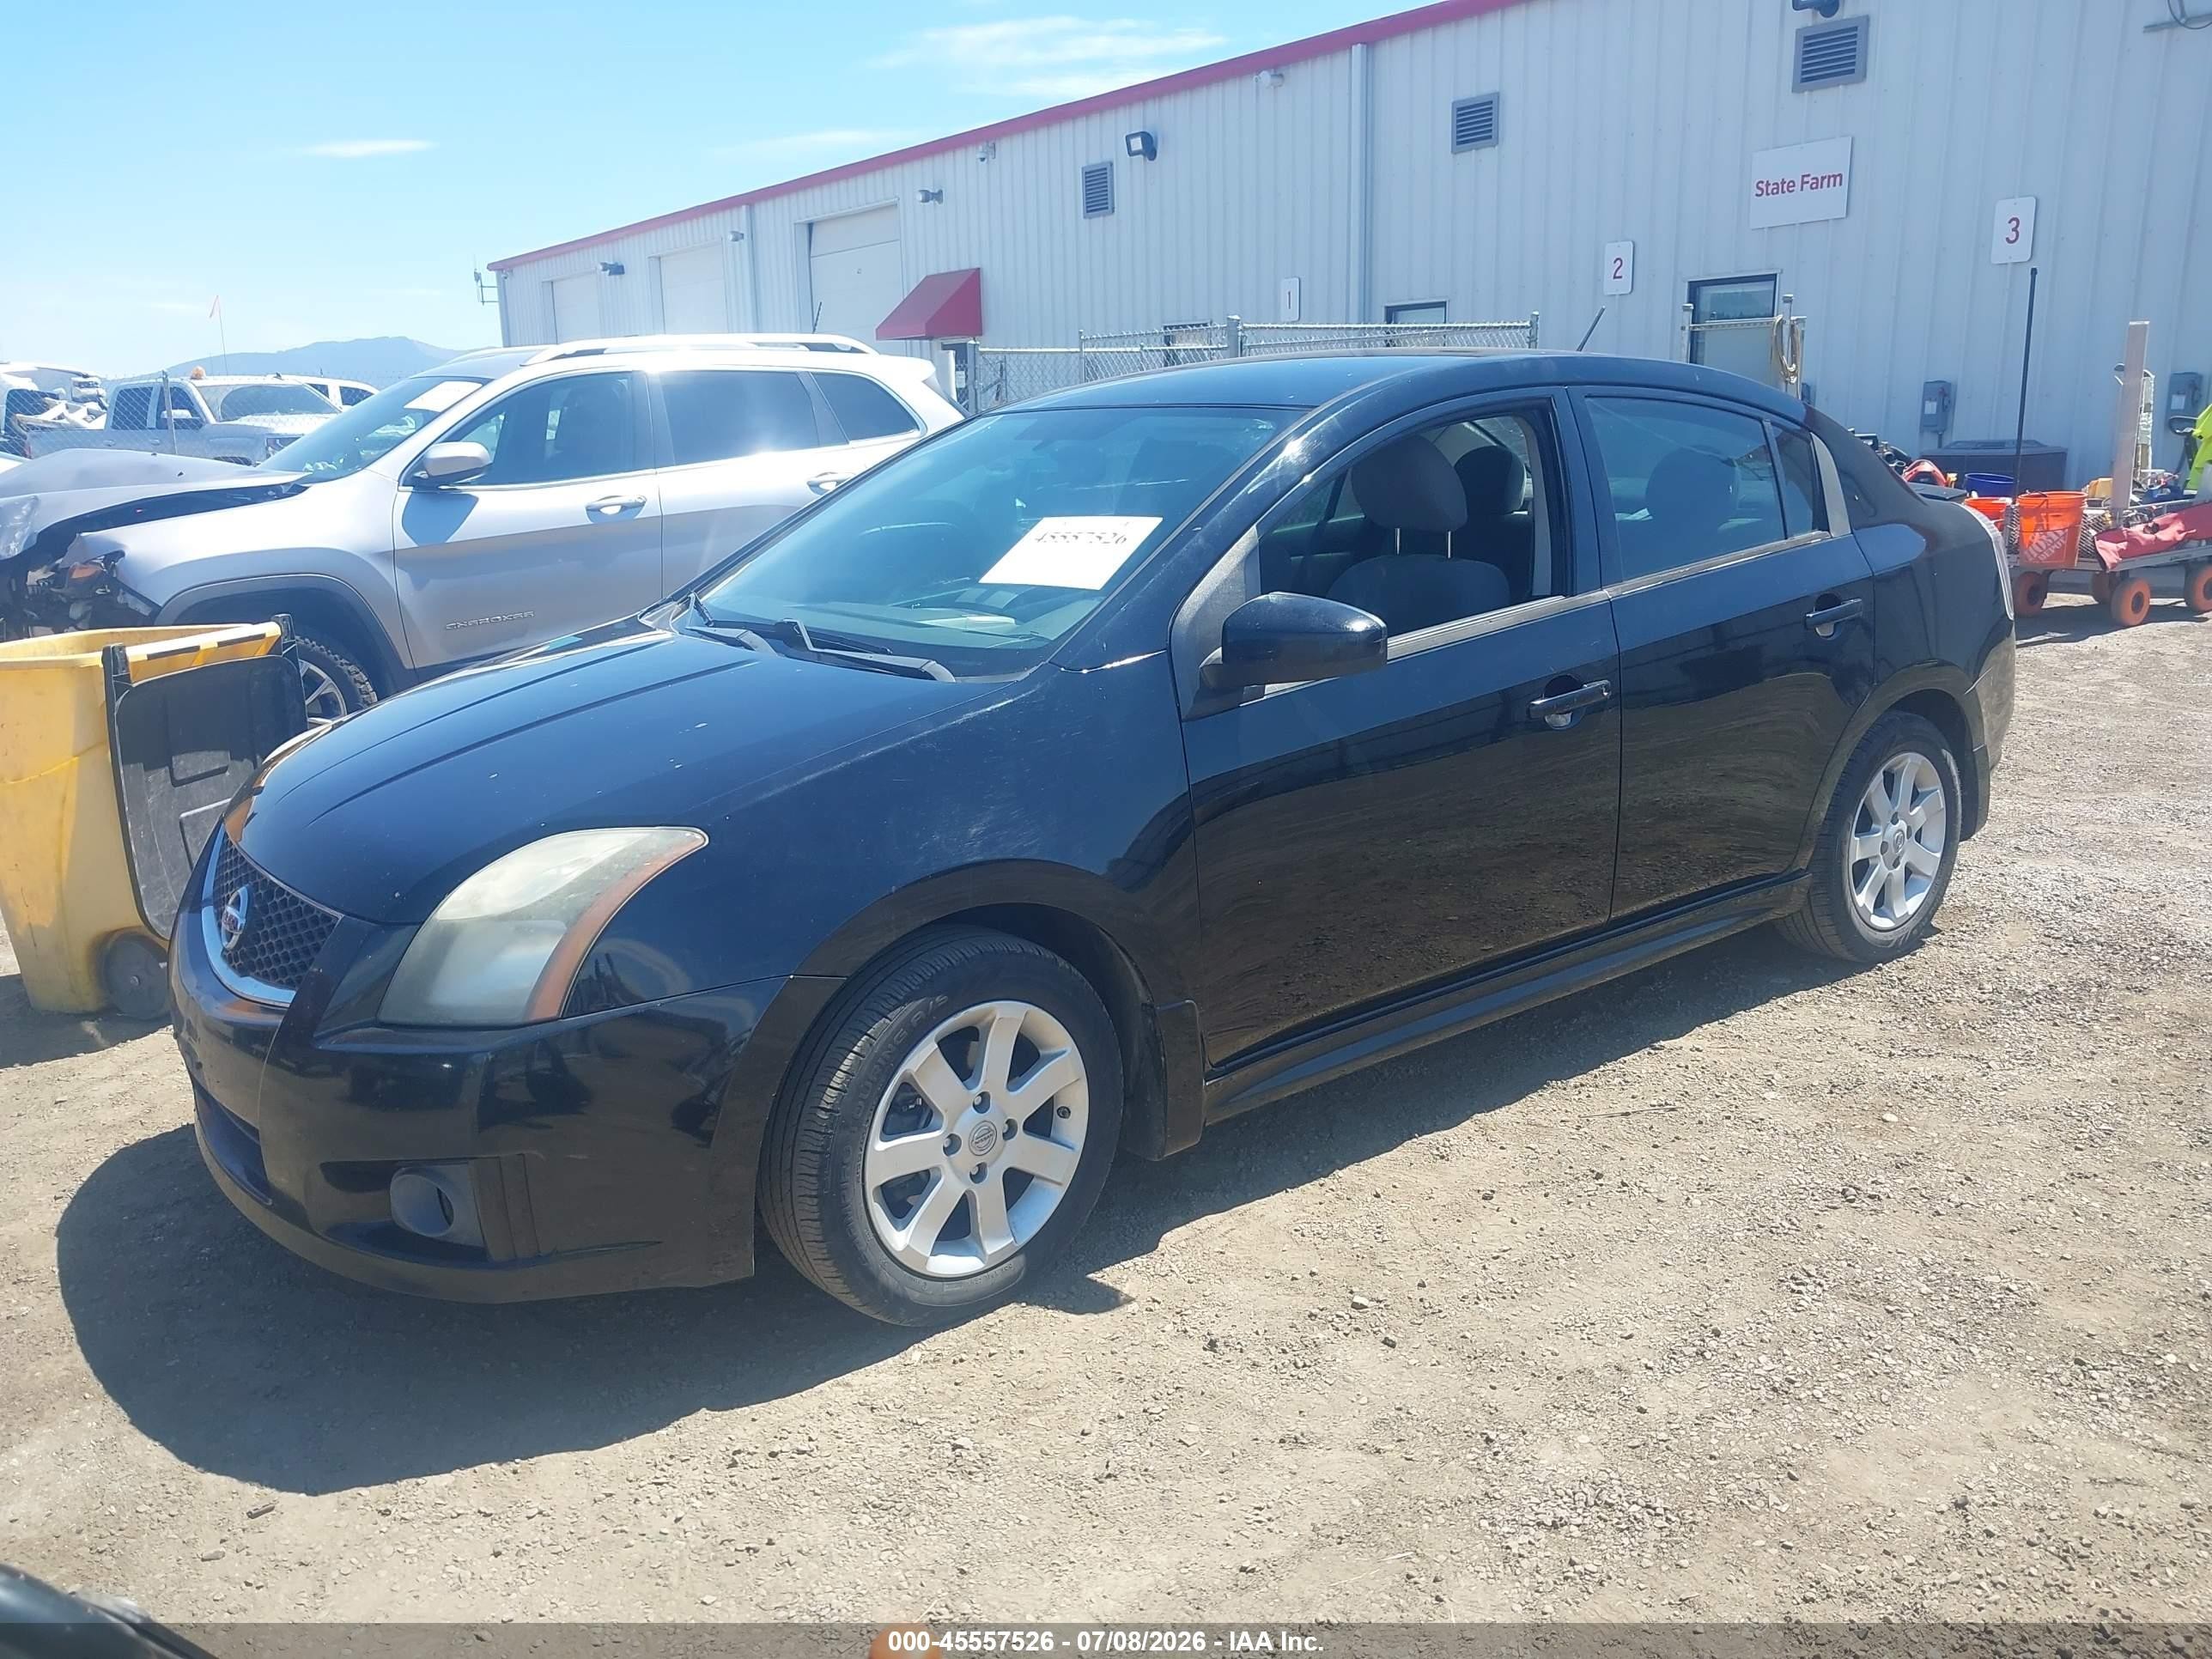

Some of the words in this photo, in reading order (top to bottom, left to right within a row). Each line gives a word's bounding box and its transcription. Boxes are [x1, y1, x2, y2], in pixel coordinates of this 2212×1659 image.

[1754, 177, 1796, 198] State
[1800, 173, 1844, 192] Farm
[2005, 217, 2021, 244] 3
[1613, 257, 1624, 280] 2
